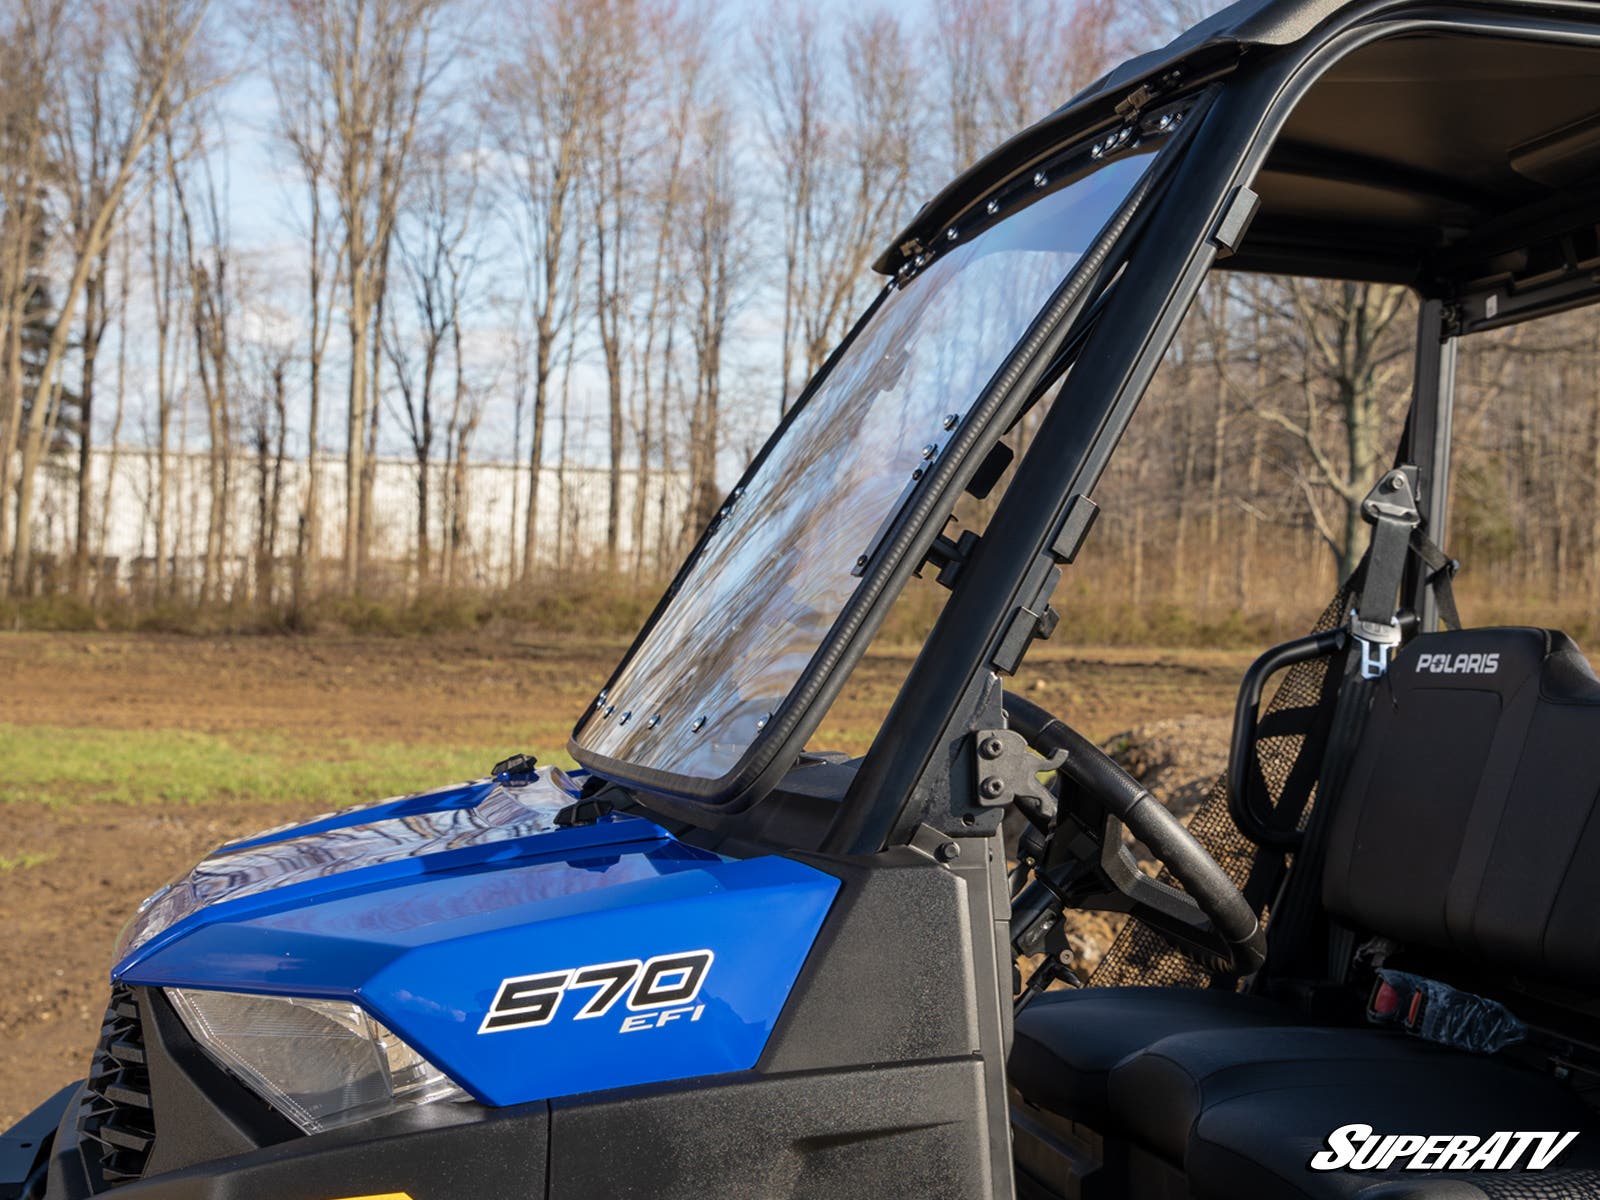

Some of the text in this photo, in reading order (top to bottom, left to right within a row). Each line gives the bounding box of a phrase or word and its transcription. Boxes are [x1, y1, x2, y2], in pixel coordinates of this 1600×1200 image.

[1415, 653, 1500, 673] POLARIS
[477, 949, 715, 1034] 570
[619, 1004, 705, 1033] EFI
